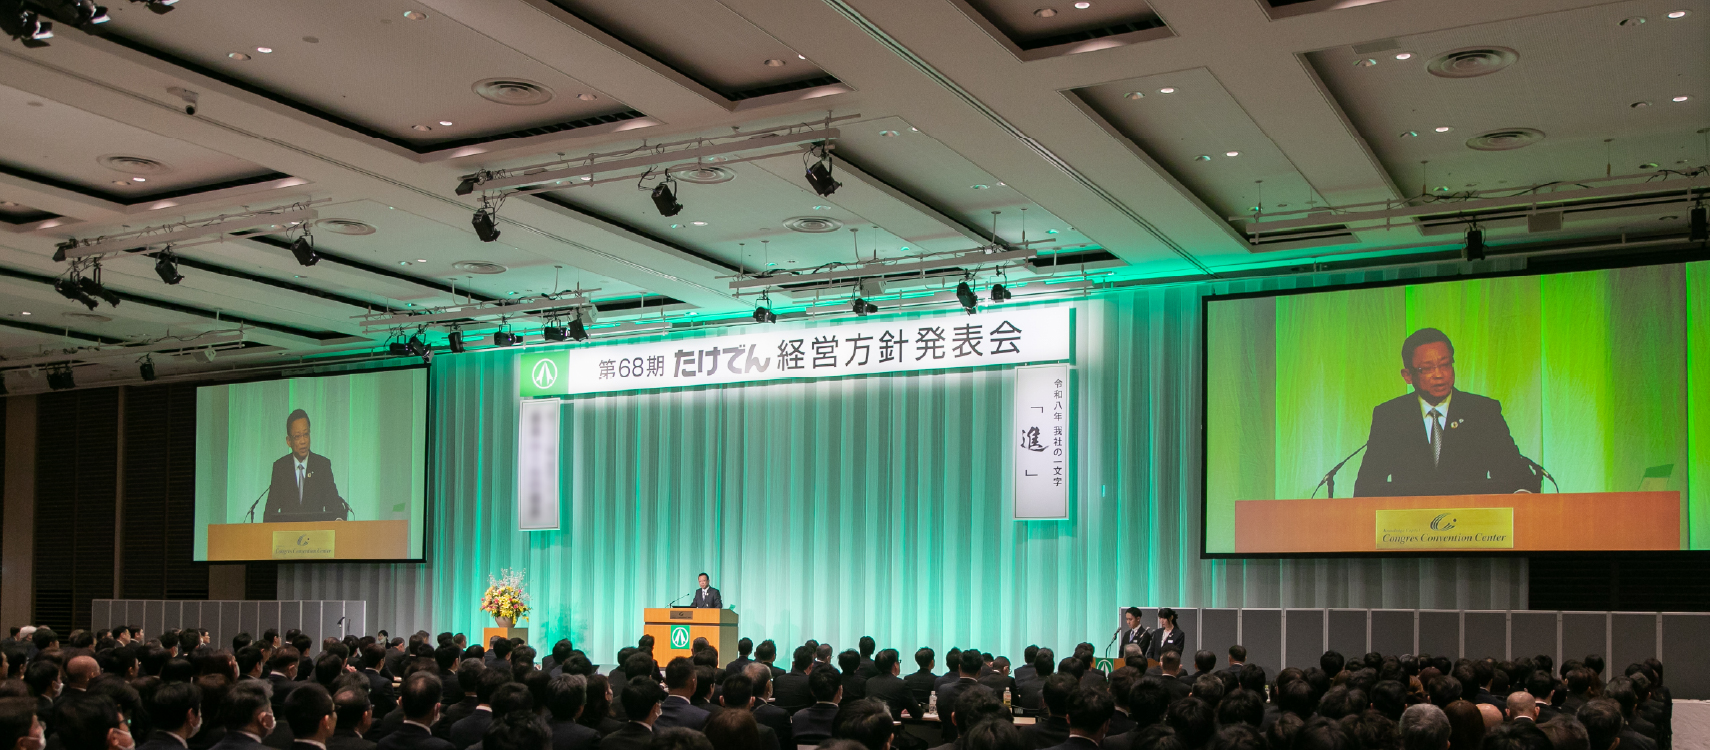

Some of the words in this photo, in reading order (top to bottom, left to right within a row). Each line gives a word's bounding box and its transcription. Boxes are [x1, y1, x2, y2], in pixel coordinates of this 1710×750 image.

[598, 354, 665, 380] 第68期
[673, 343, 771, 378] たけでん
[776, 320, 1023, 372] 経営方針発表会
[1053, 378, 1063, 422] 令和八年
[1382, 533, 1418, 544] Congres
[1420, 532, 1473, 543] Convention
[1474, 532, 1507, 542] Center
